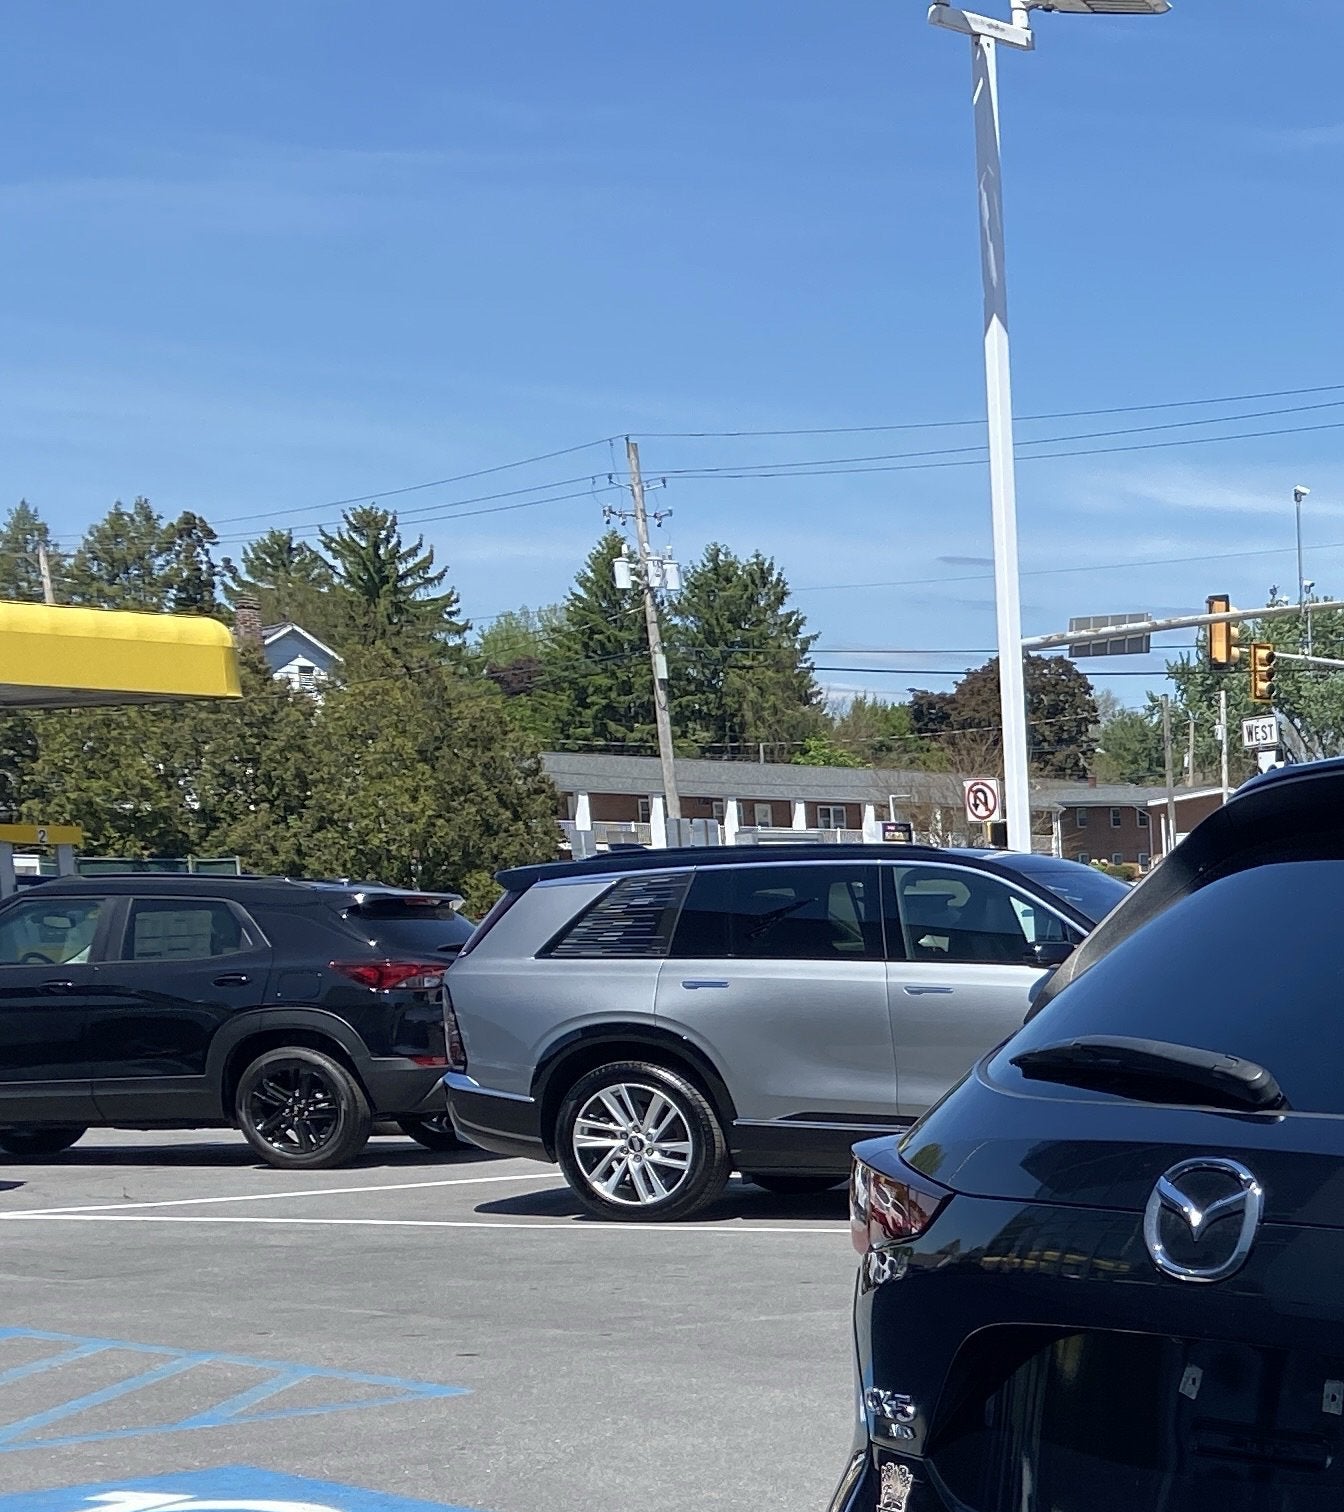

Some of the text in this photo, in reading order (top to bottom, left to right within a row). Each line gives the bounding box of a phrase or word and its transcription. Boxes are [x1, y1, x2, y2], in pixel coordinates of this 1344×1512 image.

[1245, 723, 1274, 743] WEST
[38, 829, 46, 843] 2
[866, 1386, 915, 1422] CX-5
